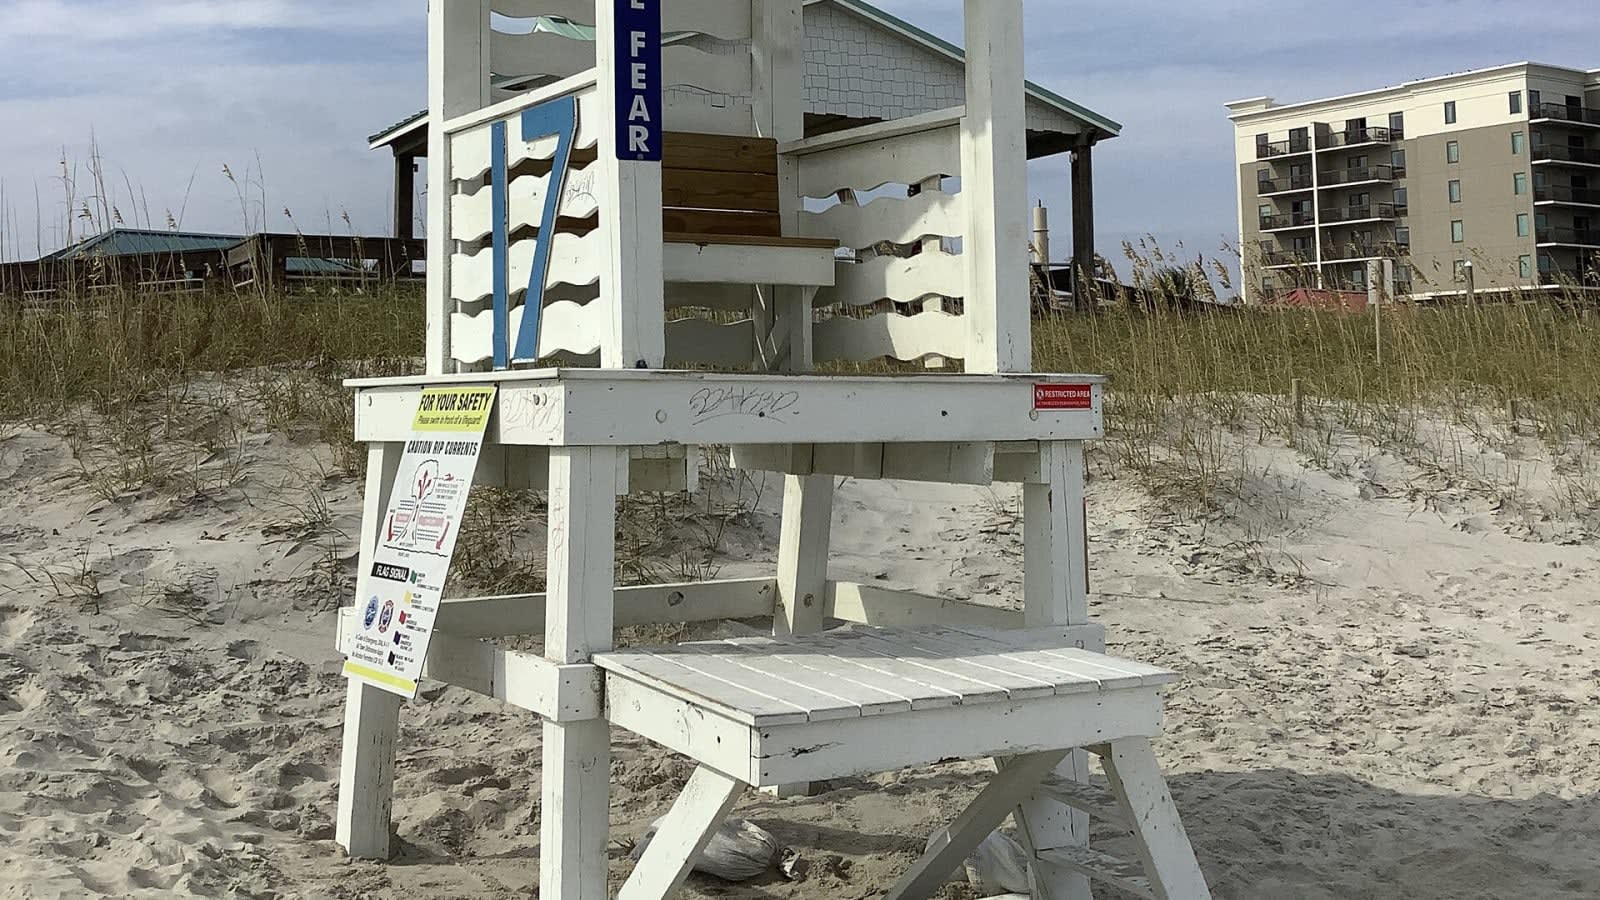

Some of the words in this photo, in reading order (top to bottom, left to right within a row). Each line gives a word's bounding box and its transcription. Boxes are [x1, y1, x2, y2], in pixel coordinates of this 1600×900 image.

[628, 31, 650, 152] FEAR
[491, 95, 577, 370] 17
[419, 394, 435, 411] FOR
[436, 393, 458, 411] YOUR
[457, 393, 491, 411] SAFETY
[1044, 390, 1077, 398] RESTRICTED
[1077, 390, 1090, 398] AREA
[407, 440, 433, 454] CAUTION
[433, 440, 445, 454] RIP
[445, 441, 478, 456] CURRENTS
[376, 565, 390, 577] FLAG
